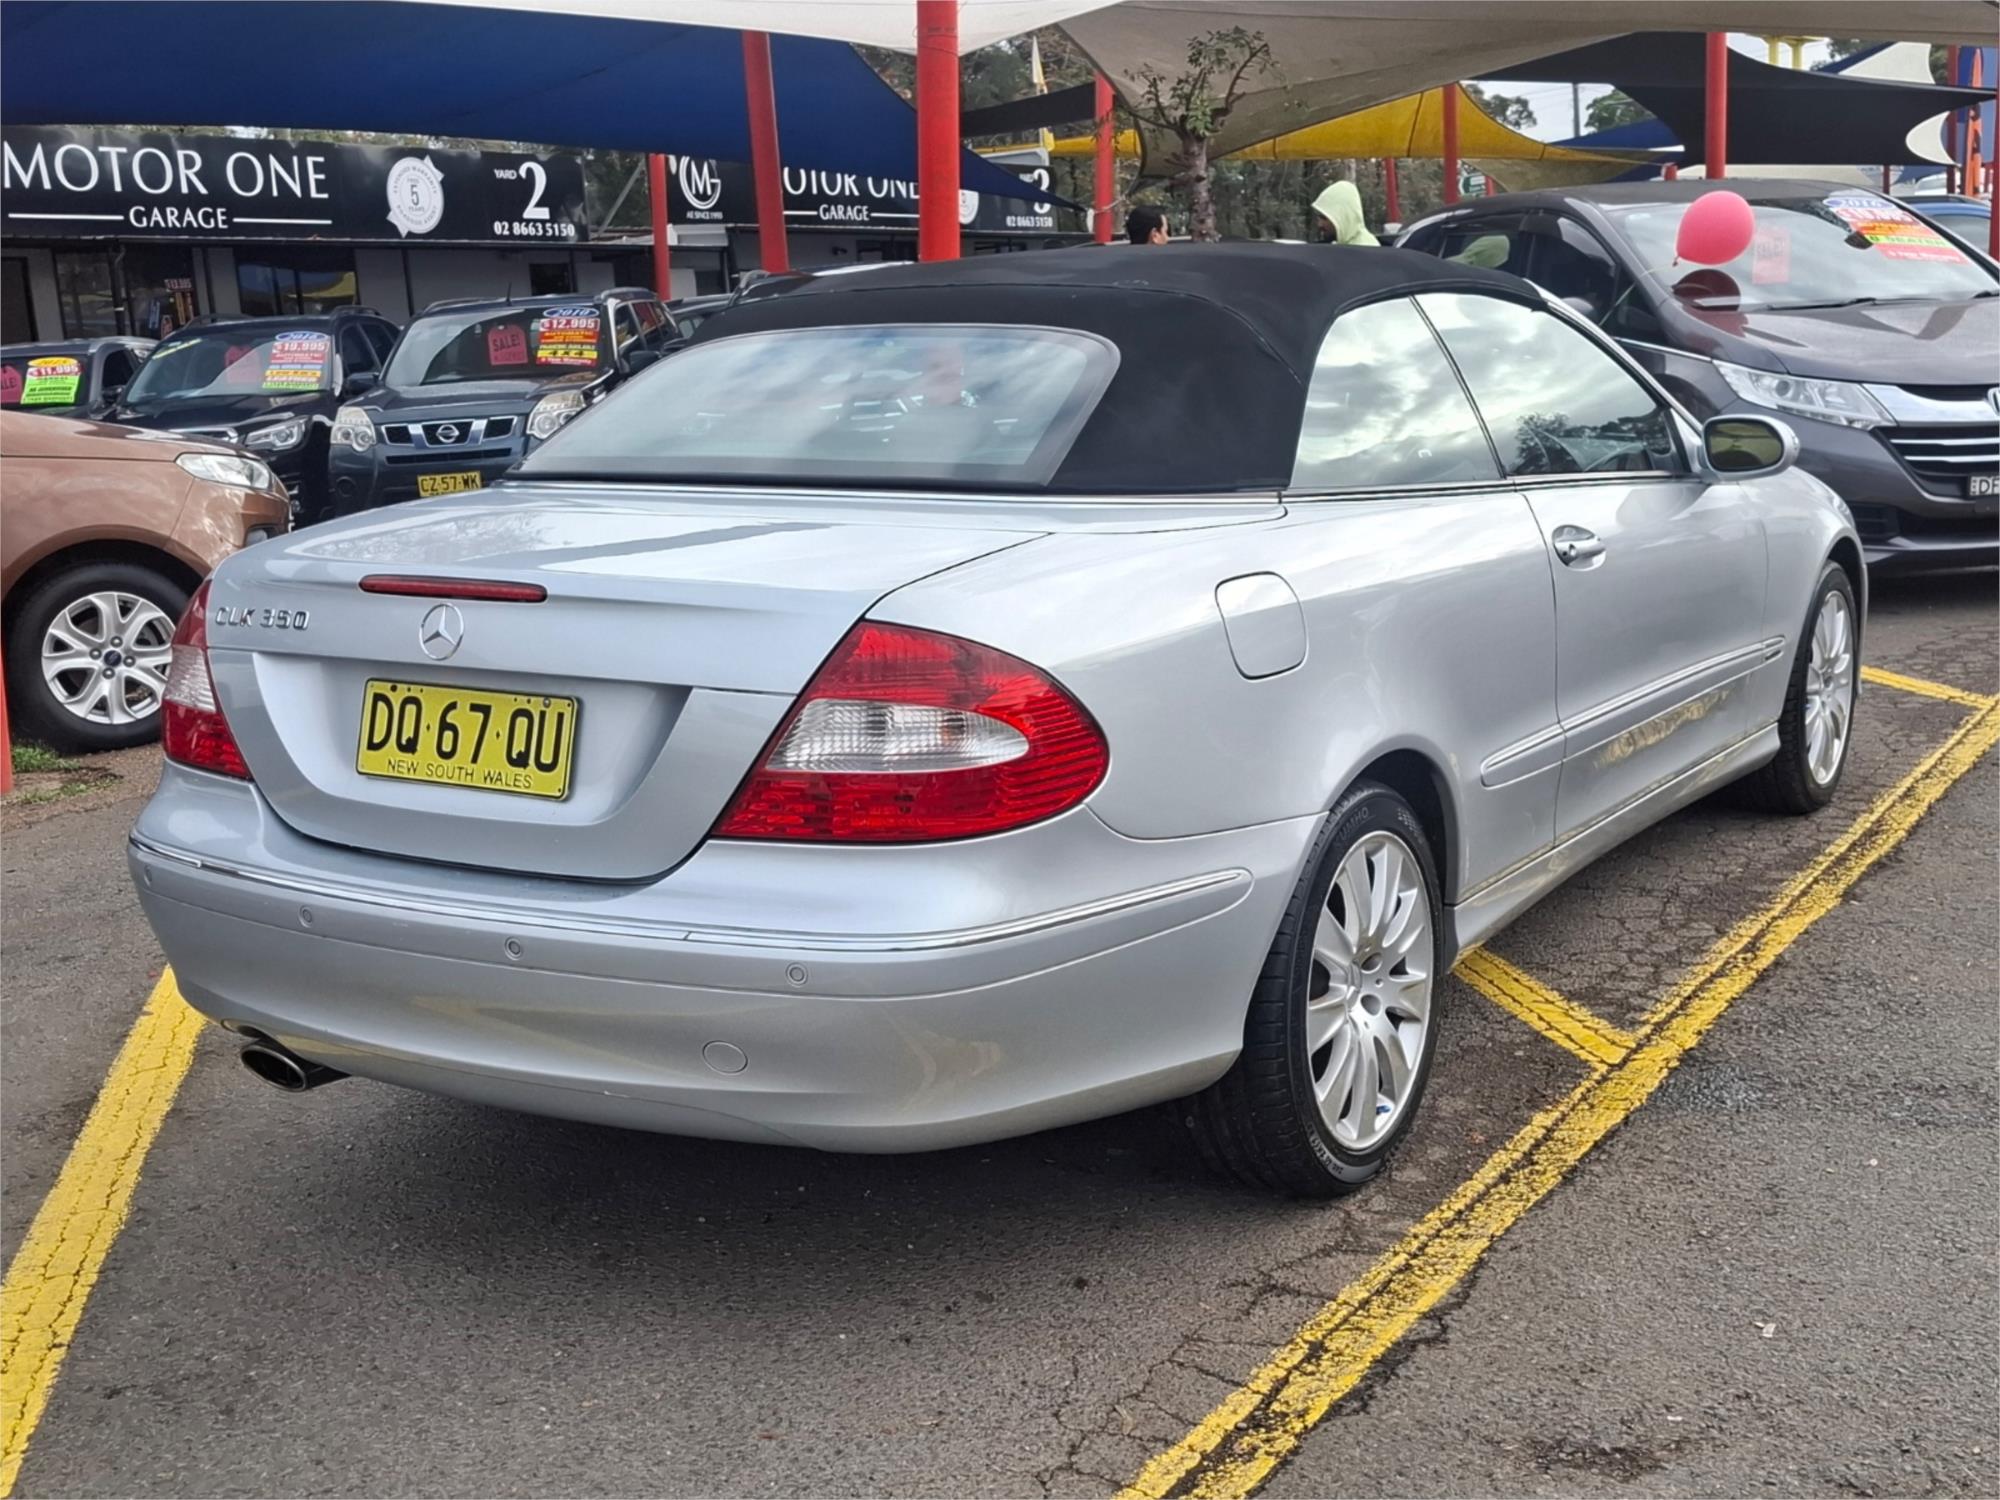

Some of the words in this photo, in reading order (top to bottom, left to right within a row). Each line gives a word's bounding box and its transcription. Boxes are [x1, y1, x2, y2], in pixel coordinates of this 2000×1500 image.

[2, 139, 209, 195] MOTOR
[225, 151, 330, 199] ONE
[410, 184, 420, 206] 5
[493, 168, 518, 180] YARD
[518, 161, 551, 220] 2
[128, 205, 229, 230] GARAGE
[819, 203, 870, 221] GARAGE
[493, 221, 511, 236] 02
[512, 221, 544, 237] 8663
[545, 222, 576, 237] 5150
[215, 606, 255, 627] CLK
[259, 608, 310, 631] 350
[387, 758, 420, 776] NEW
[425, 763, 476, 781] SOUTH
[483, 769, 533, 789] WALES
